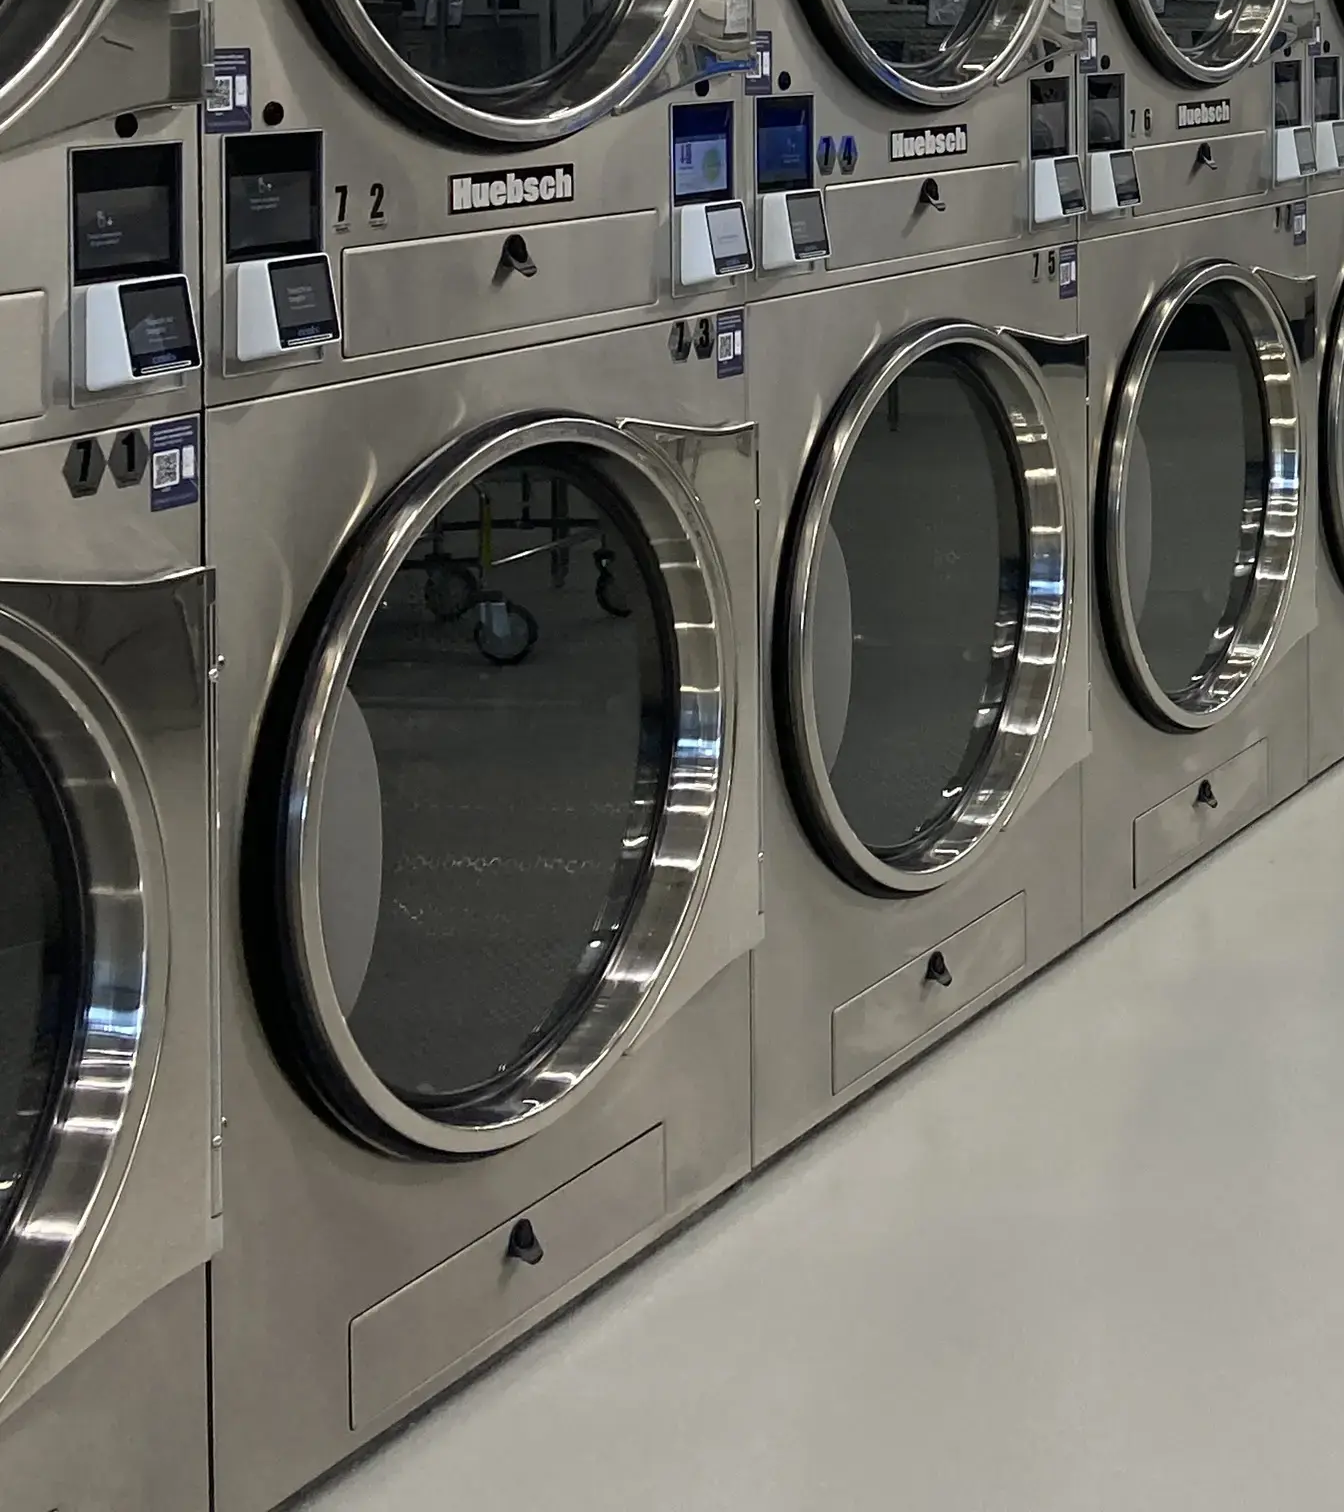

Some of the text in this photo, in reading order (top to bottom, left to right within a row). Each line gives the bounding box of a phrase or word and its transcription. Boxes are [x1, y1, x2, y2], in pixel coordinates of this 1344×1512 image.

[1178, 100, 1230, 126] Huebsch
[892, 126, 966, 158] Huebsch
[452, 168, 572, 210] Huebsch
